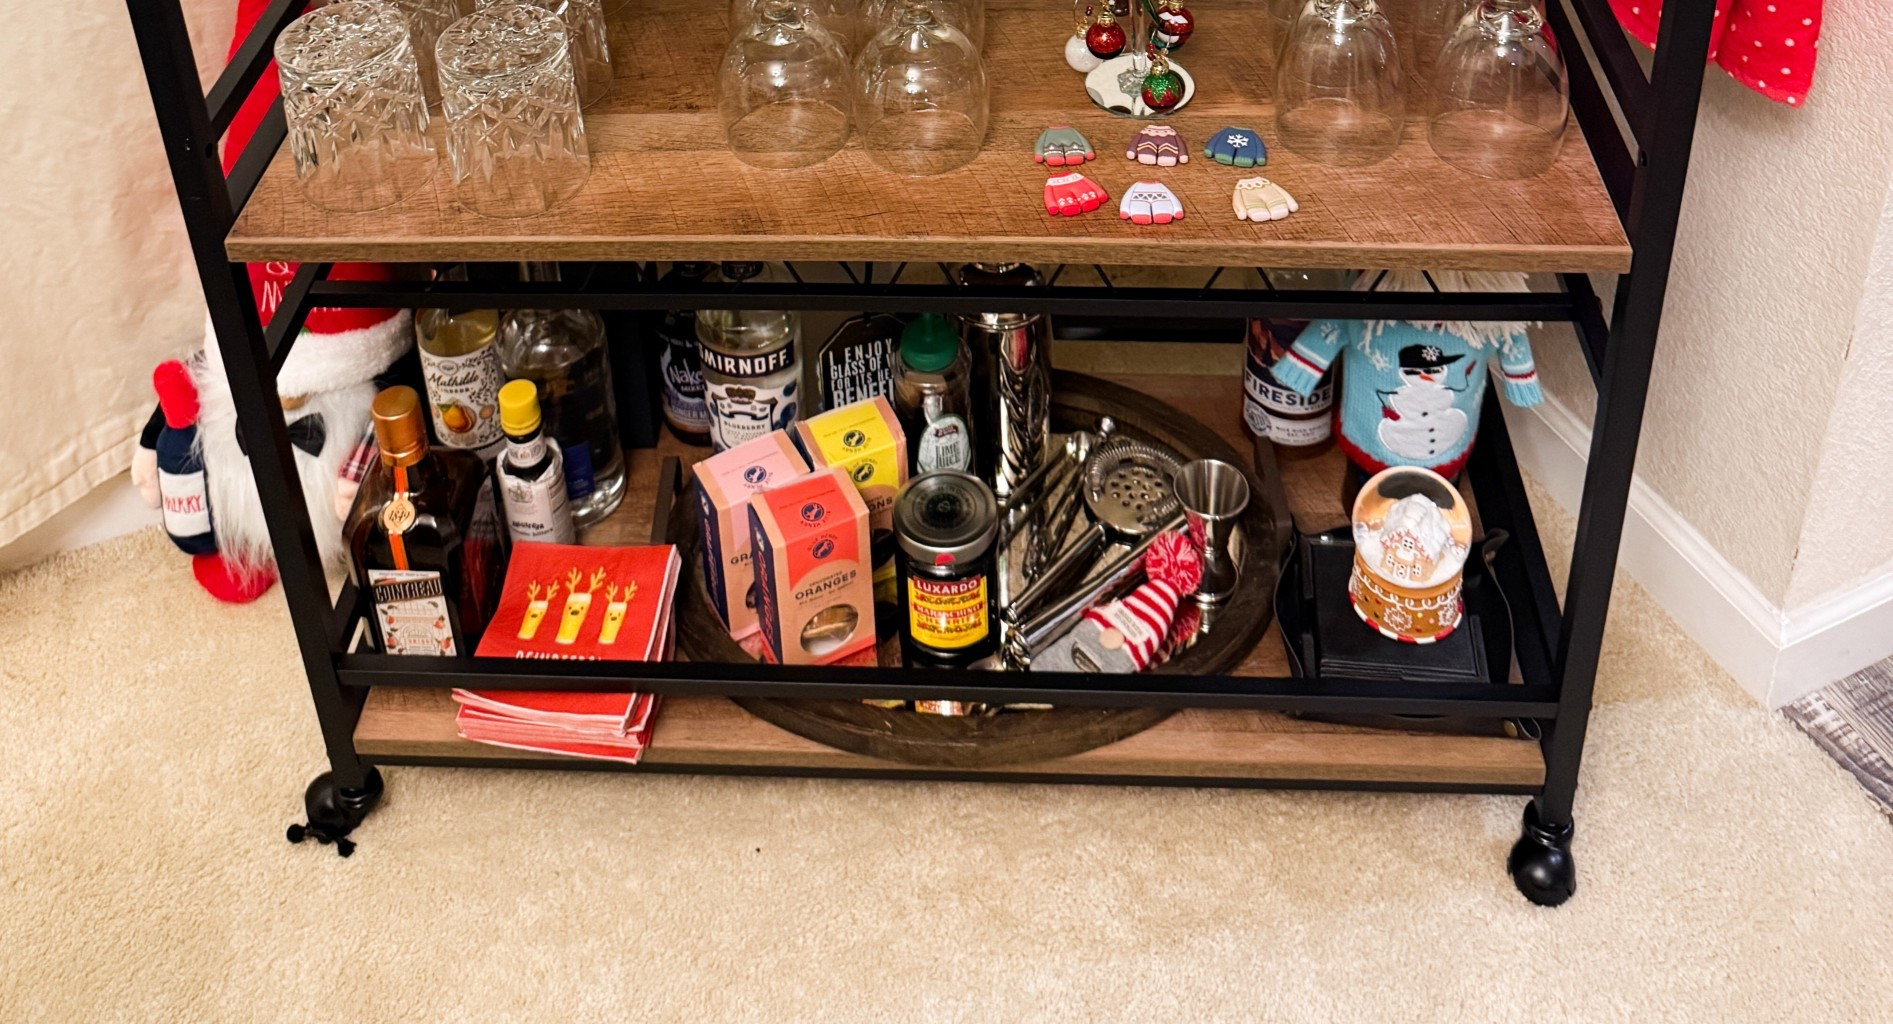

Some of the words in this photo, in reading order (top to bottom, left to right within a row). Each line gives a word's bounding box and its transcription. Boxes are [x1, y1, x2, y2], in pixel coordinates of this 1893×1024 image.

[829, 351, 834, 366] I
[845, 338, 892, 363] ENJOY
[428, 370, 479, 387] Mathilde
[830, 359, 865, 380] GLASS
[870, 356, 881, 372] OF
[831, 377, 850, 392] FOR
[856, 372, 873, 387] ITS
[833, 379, 895, 408] BENEFI
[1246, 370, 1331, 406] FIRESIDE
[724, 421, 765, 430] BLUEBERRY
[389, 510, 410, 522] 1849
[376, 578, 442, 602] COINTREAU
[795, 569, 857, 601] ORANGES
[917, 579, 978, 594] LUXARDO
